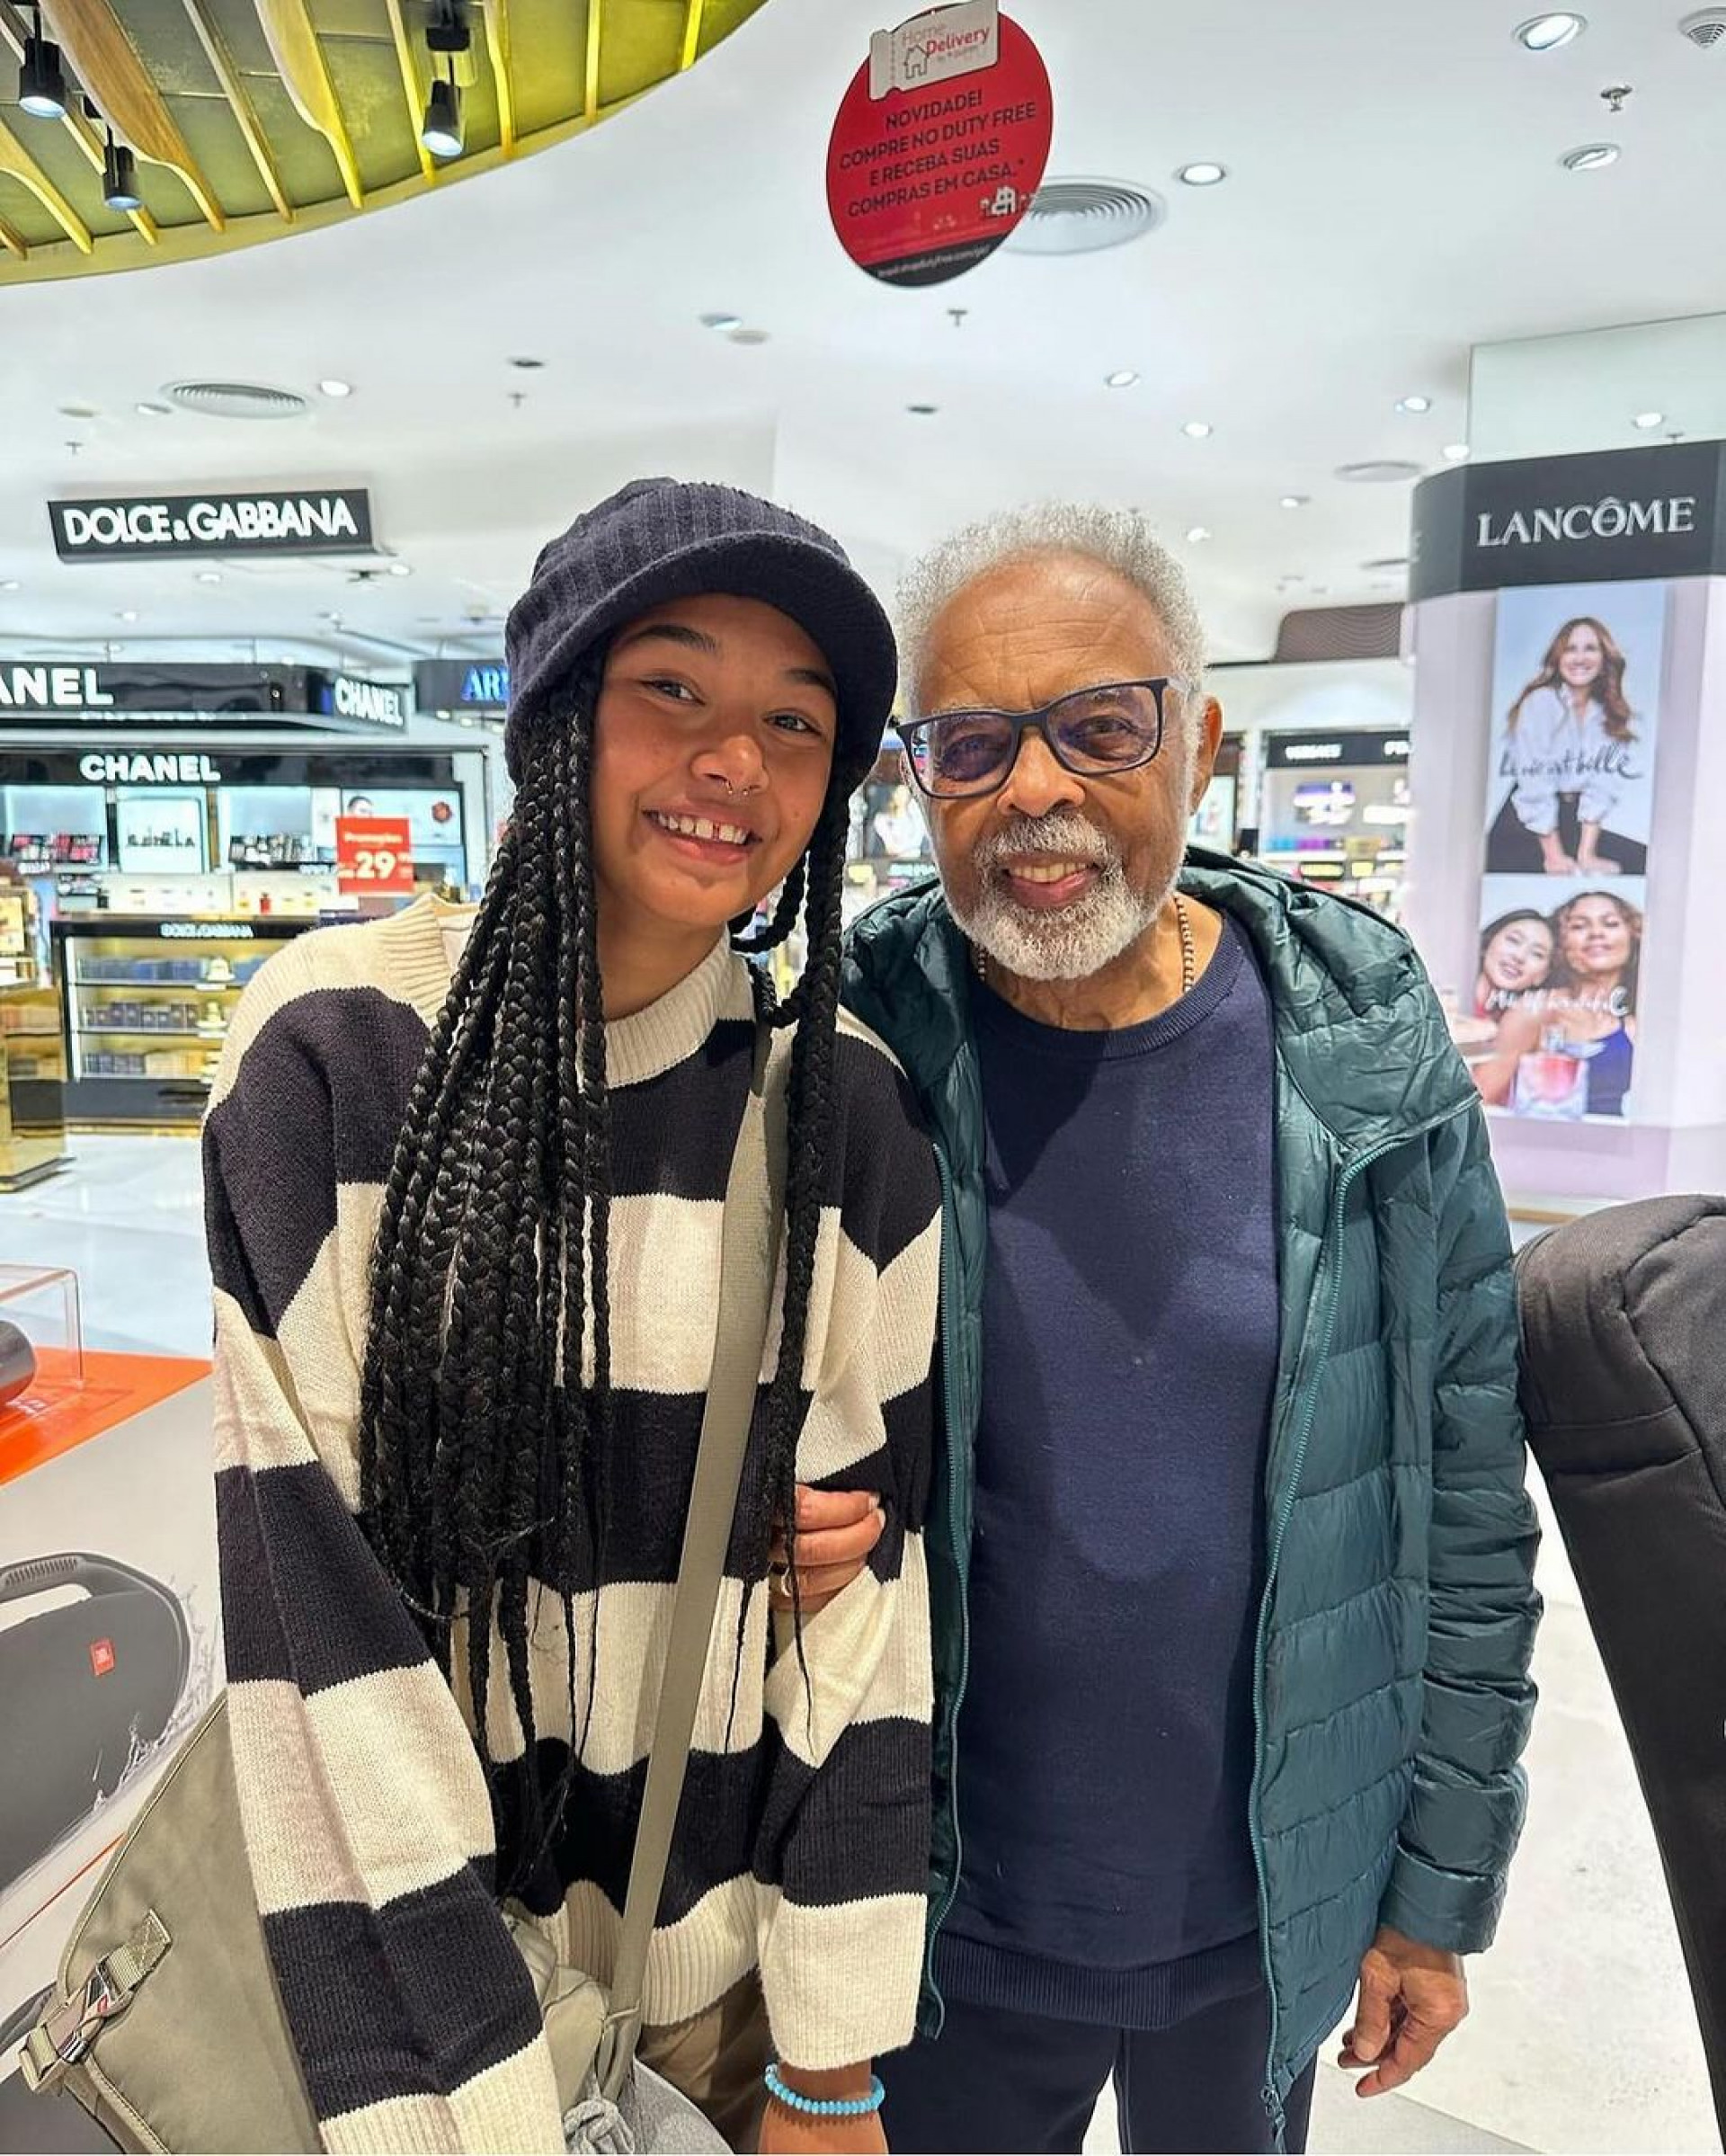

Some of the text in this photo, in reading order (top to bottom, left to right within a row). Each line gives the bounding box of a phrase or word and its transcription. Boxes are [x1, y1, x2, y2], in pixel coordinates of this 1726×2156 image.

[926, 25, 990, 55] Delivery
[885, 89, 983, 131] NOVIDADE!
[841, 102, 1036, 170] COMPRE NO DUTY FREE
[869, 138, 1001, 186] E RECEBA SUAS
[848, 182, 931, 218] COMPRAS
[934, 177, 959, 195] EM
[1477, 496, 1696, 548] LANCÔME
[334, 676, 404, 726] CHANEL
[460, 664, 511, 703] AR
[79, 753, 222, 782] CHANEL
[354, 850, 397, 879] 29
